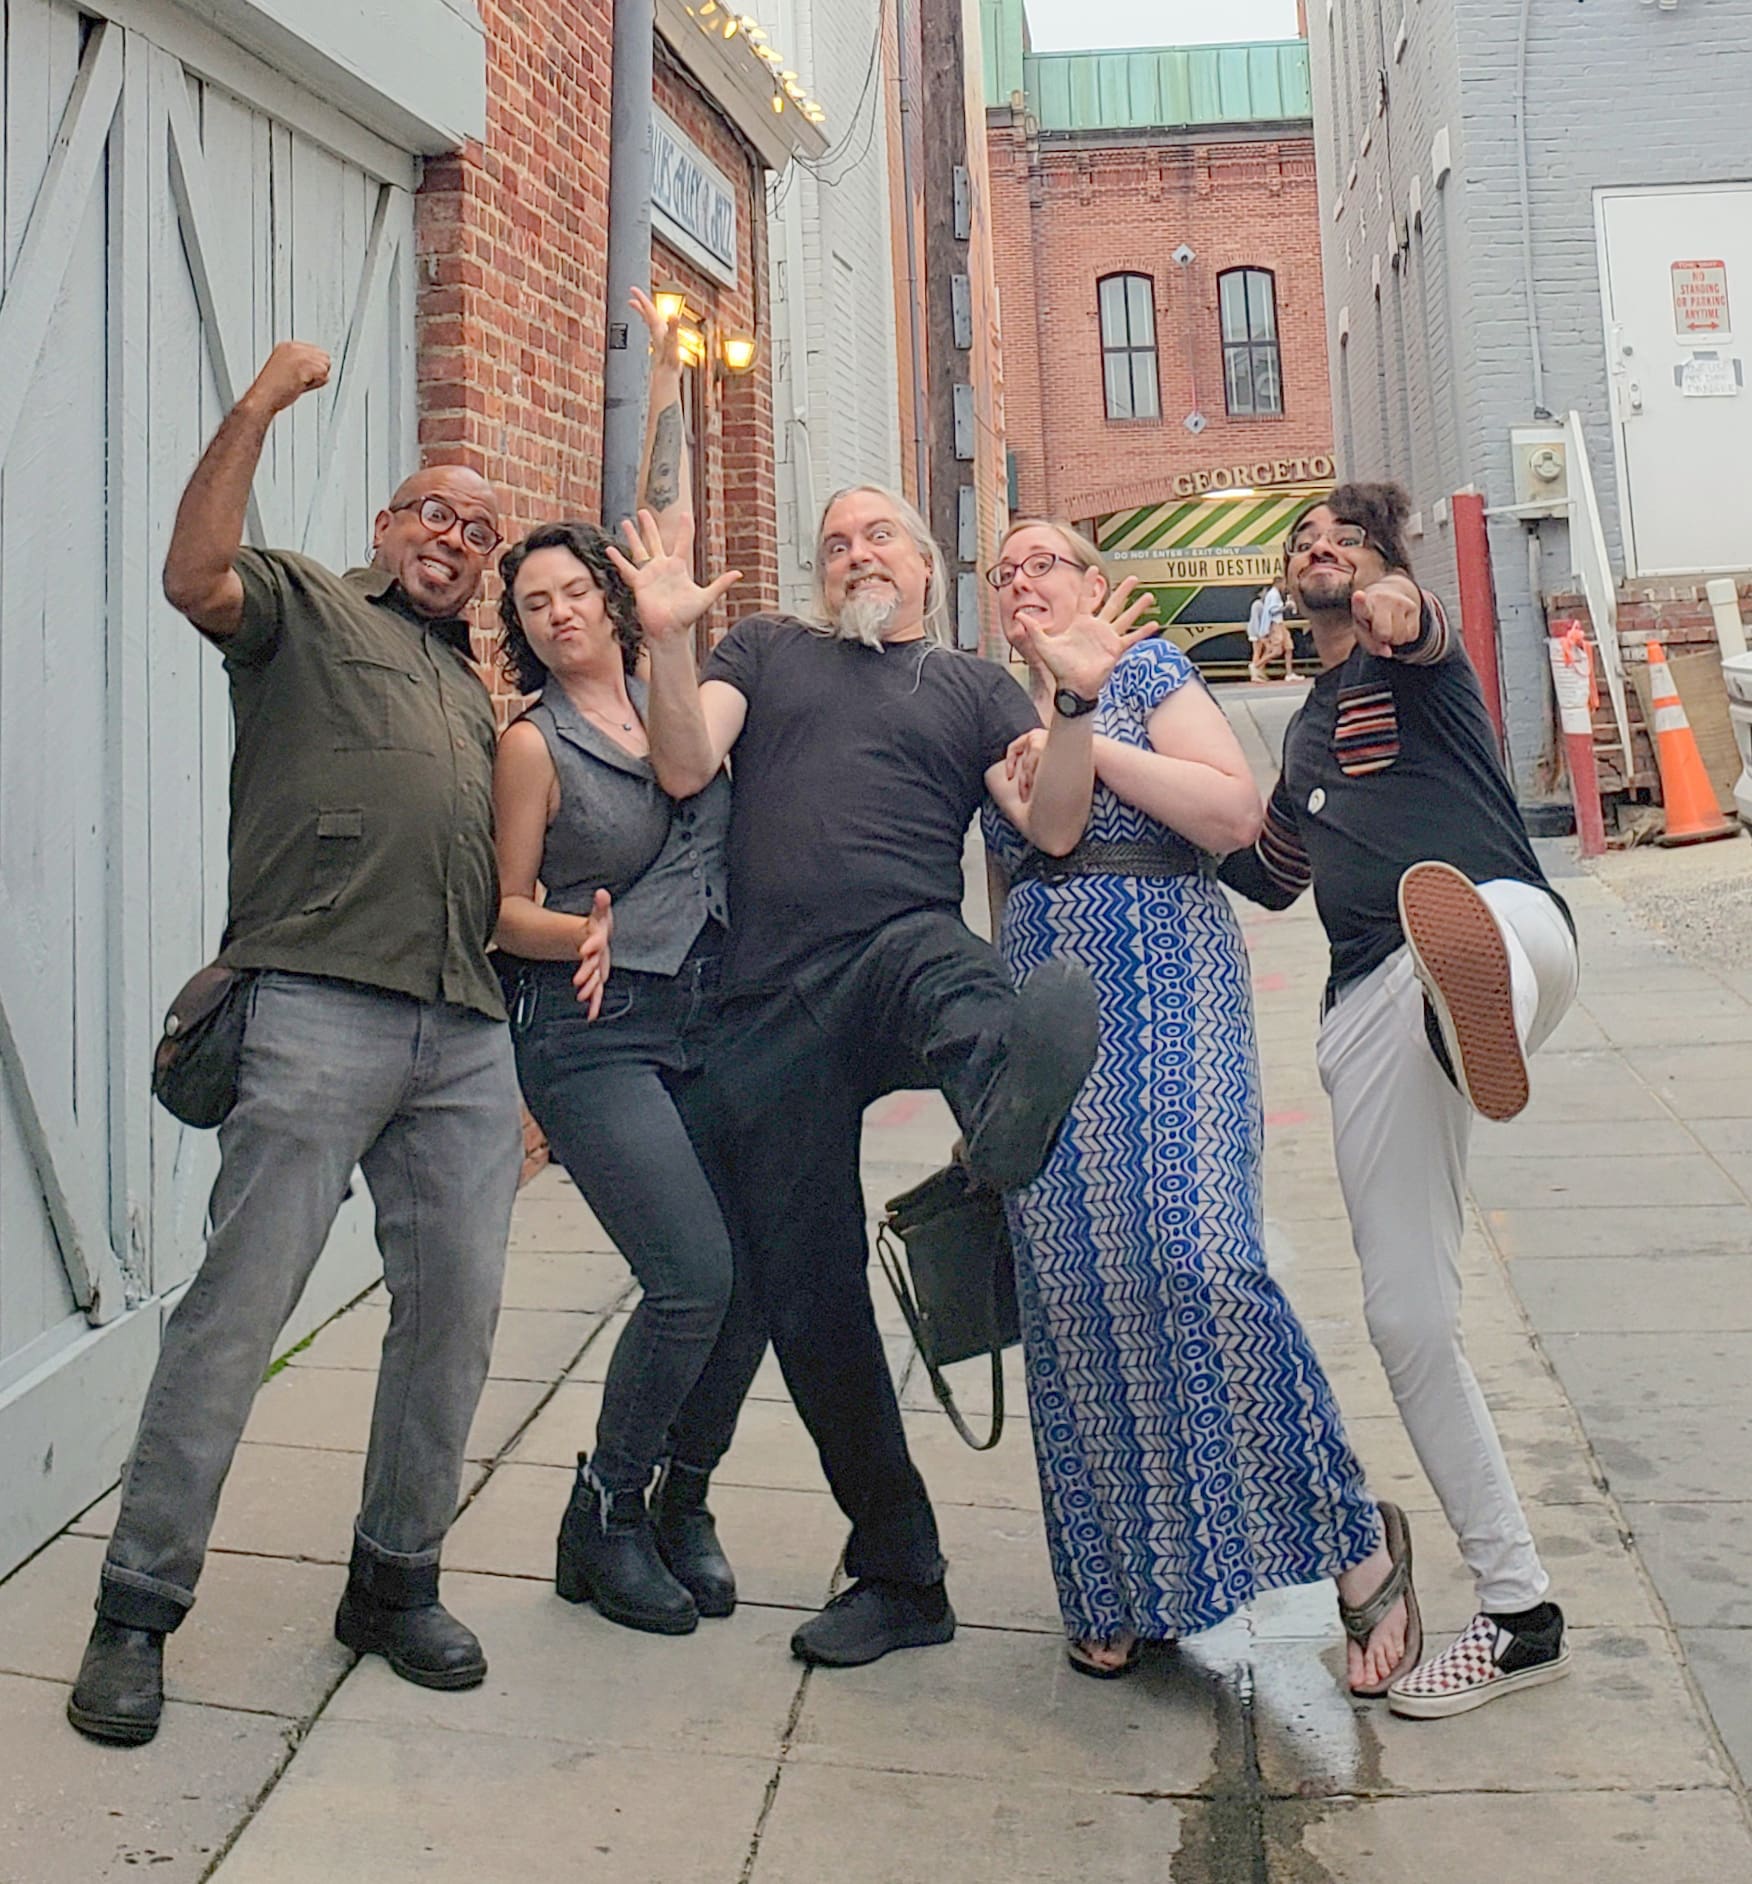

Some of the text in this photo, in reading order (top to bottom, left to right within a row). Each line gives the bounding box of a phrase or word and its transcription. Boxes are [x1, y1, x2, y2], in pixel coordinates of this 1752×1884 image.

[650, 126, 673, 208] UES
[1692, 271, 1704, 281] NO
[1680, 283, 1720, 295] STANDING
[1676, 295, 1725, 307] OR PARKING
[1685, 308, 1719, 319] ANYTIME
[1173, 454, 1336, 497] GEORGETO
[1114, 551, 1128, 560] DO
[1130, 550, 1149, 559] NOT
[1152, 549, 1183, 558] ENTER
[1192, 548, 1212, 557] EXIT
[1215, 547, 1240, 556] ONLY
[1167, 557, 1283, 577] YOUR DESTINA
